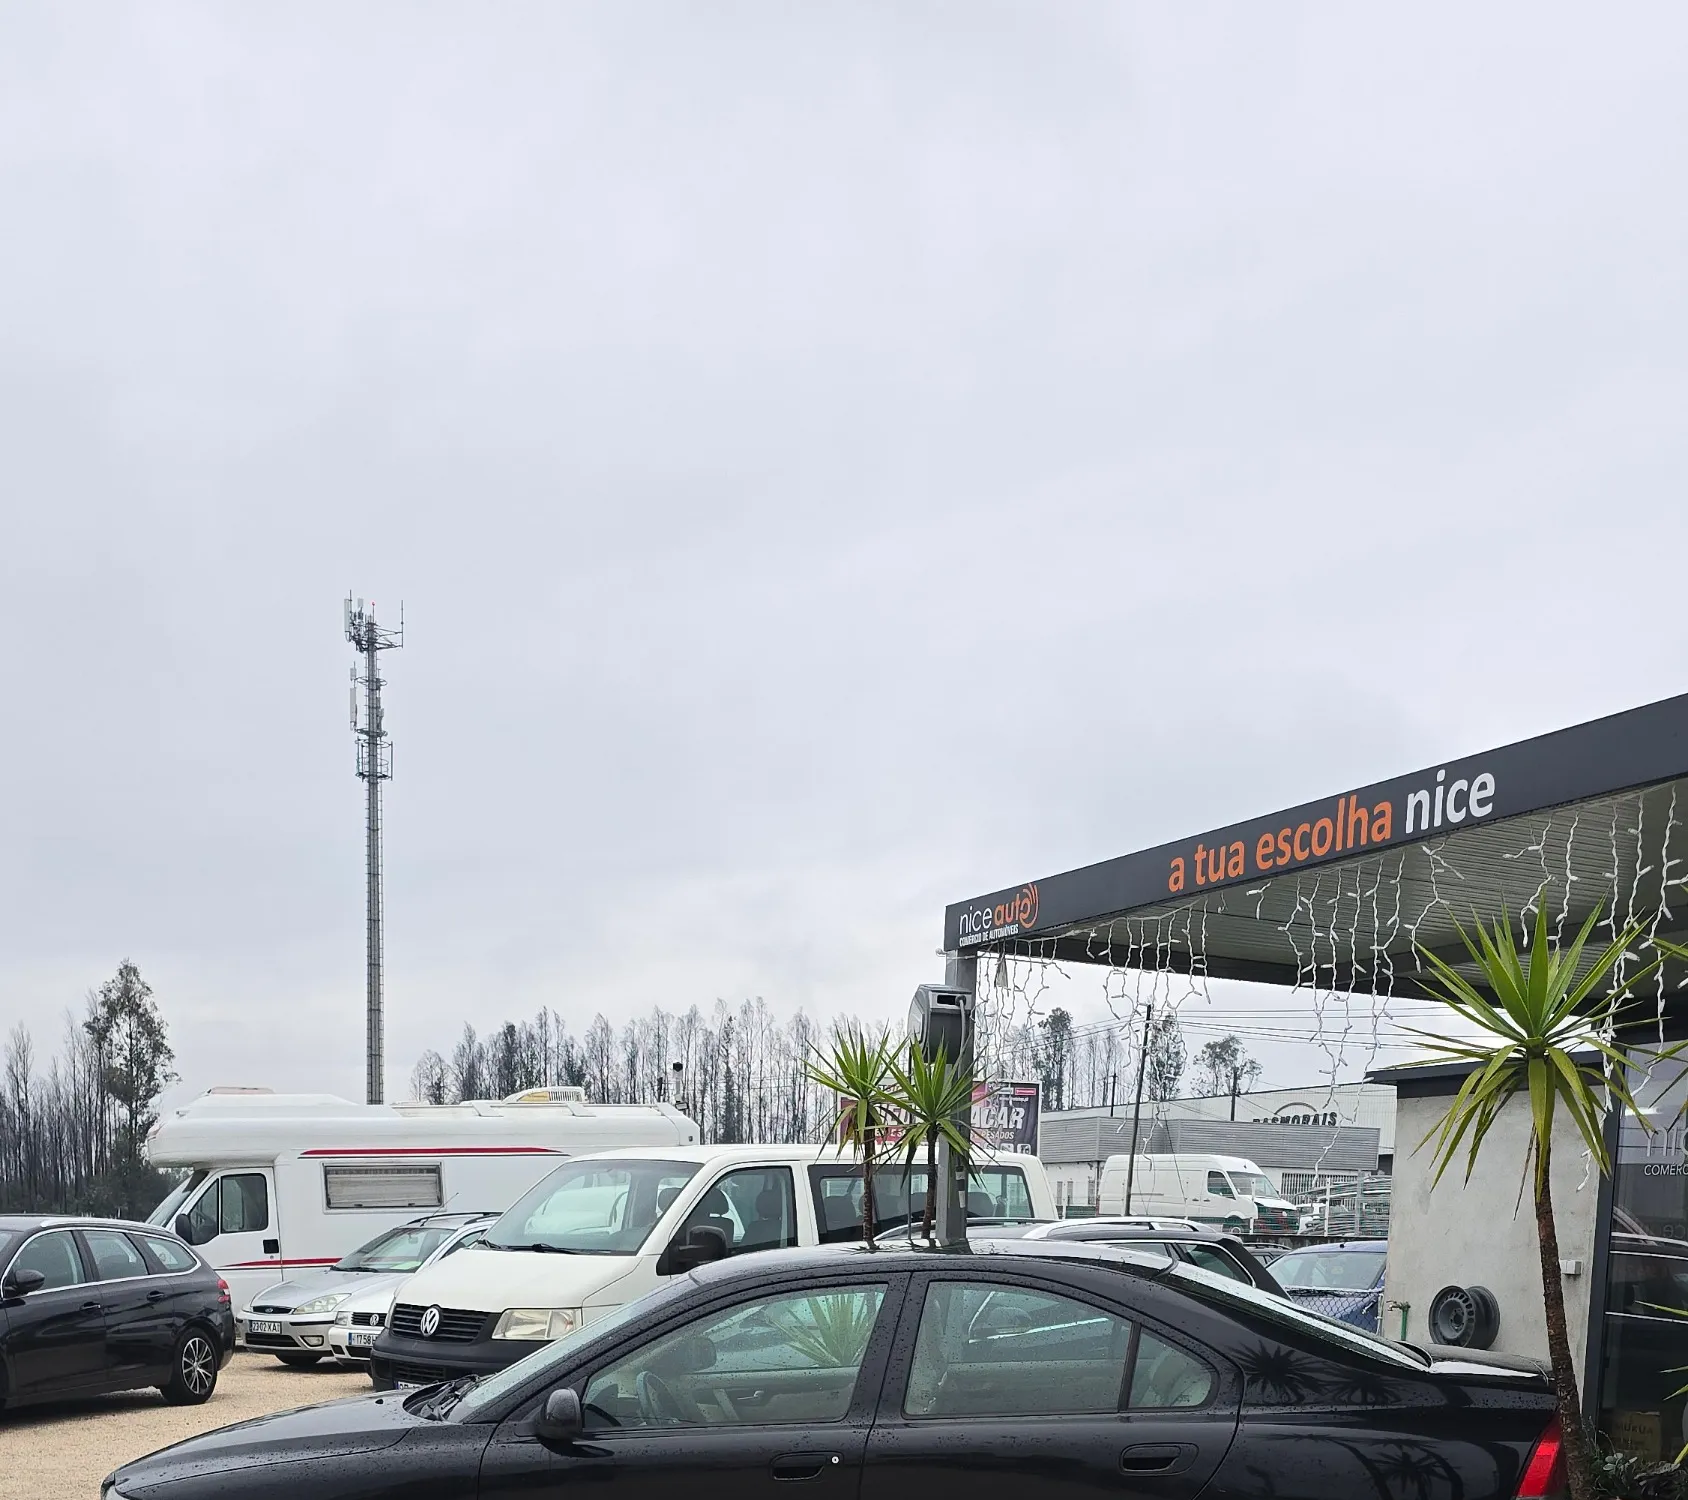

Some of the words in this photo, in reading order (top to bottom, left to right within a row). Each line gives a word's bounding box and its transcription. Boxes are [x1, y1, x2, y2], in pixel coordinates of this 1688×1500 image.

[1168, 856, 1185, 892] a
[1194, 840, 1245, 886] tua
[1255, 794, 1393, 870] escolha
[1404, 769, 1496, 834] nice
